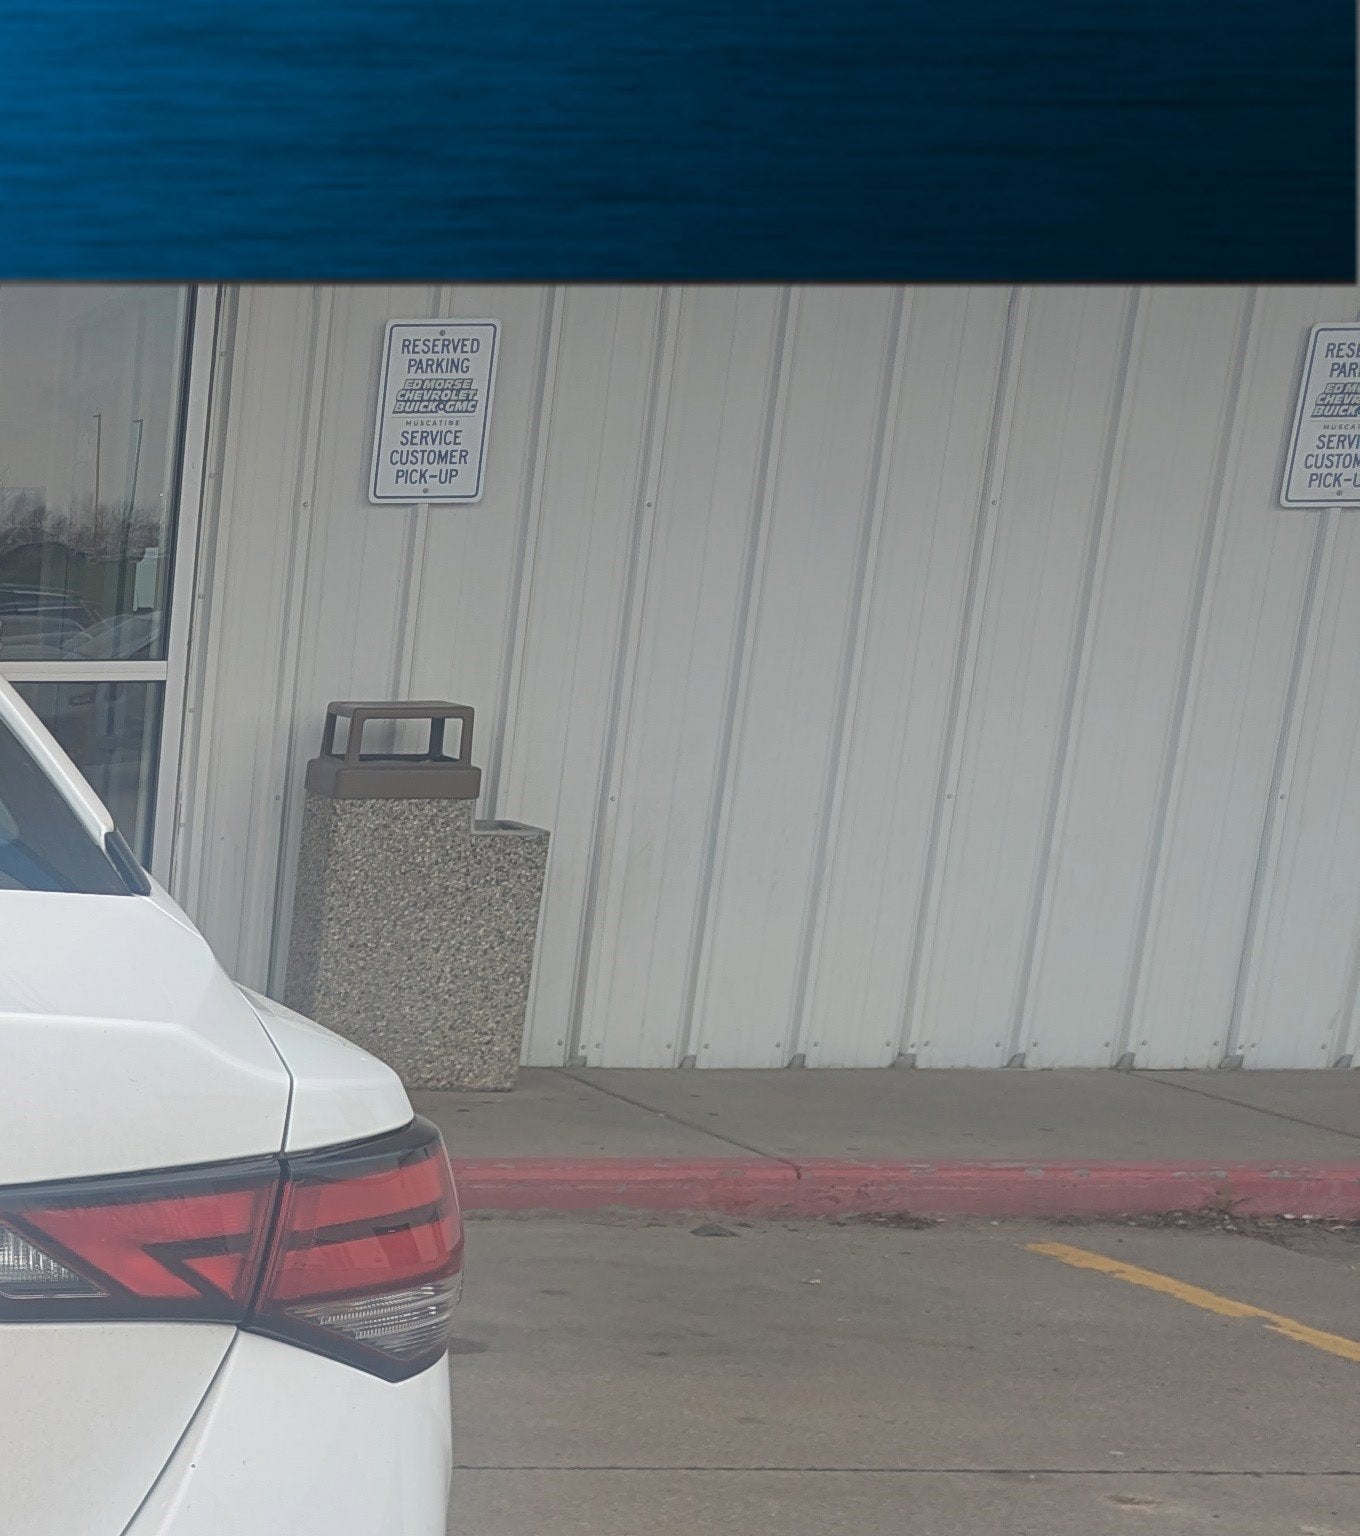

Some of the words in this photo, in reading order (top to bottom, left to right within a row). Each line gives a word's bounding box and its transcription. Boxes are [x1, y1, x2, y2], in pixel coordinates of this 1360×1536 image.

[401, 338, 480, 354] RESERVED
[407, 358, 471, 374] PARKING
[1329, 362, 1360, 378] PAR
[404, 378, 423, 389] ED
[423, 378, 473, 389] MORSE
[1324, 383, 1344, 393] ED
[396, 389, 478, 400] CHEVROLET
[393, 400, 437, 413] BUICK
[445, 400, 478, 413] GMC
[1311, 405, 1358, 418] BUICK
[399, 430, 463, 446] SERVICE
[389, 450, 469, 465] CUSTOMER
[395, 469, 459, 485] PICK-UP
